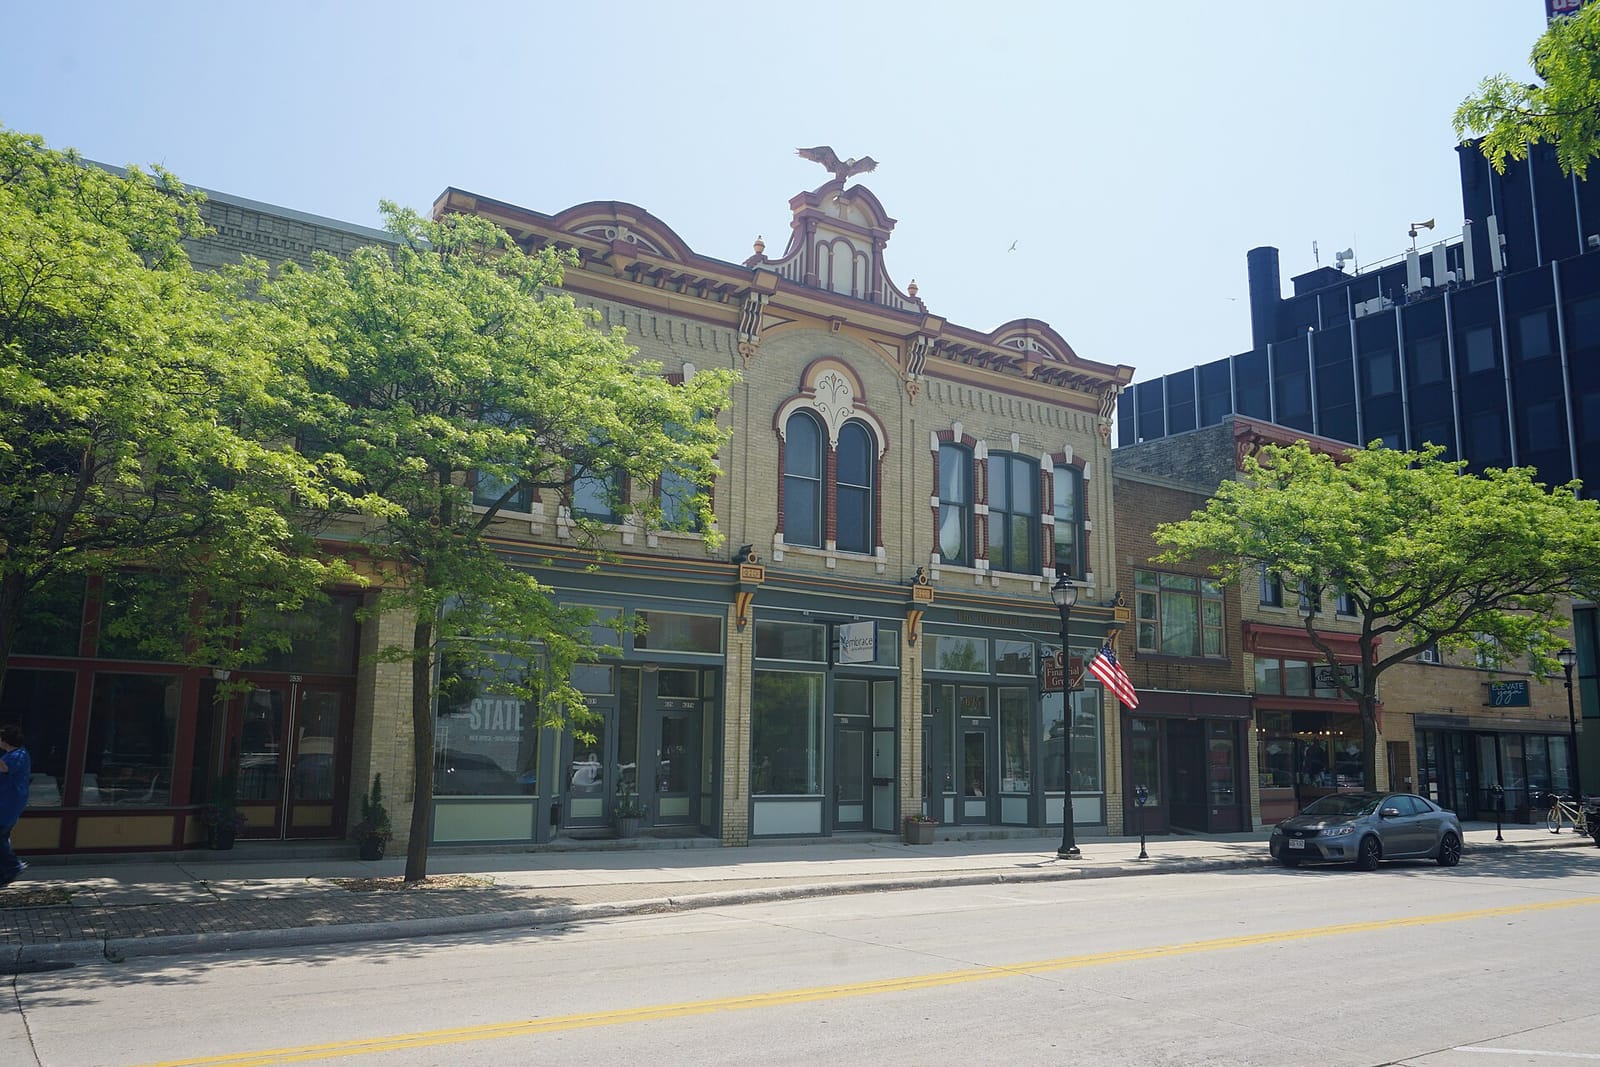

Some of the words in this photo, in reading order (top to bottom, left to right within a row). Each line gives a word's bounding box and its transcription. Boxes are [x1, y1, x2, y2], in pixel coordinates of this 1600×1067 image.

[846, 636, 873, 649] embrace
[1491, 682, 1525, 691] ELEVATE
[1496, 690, 1523, 705] yoga
[470, 698, 525, 731] STATE
